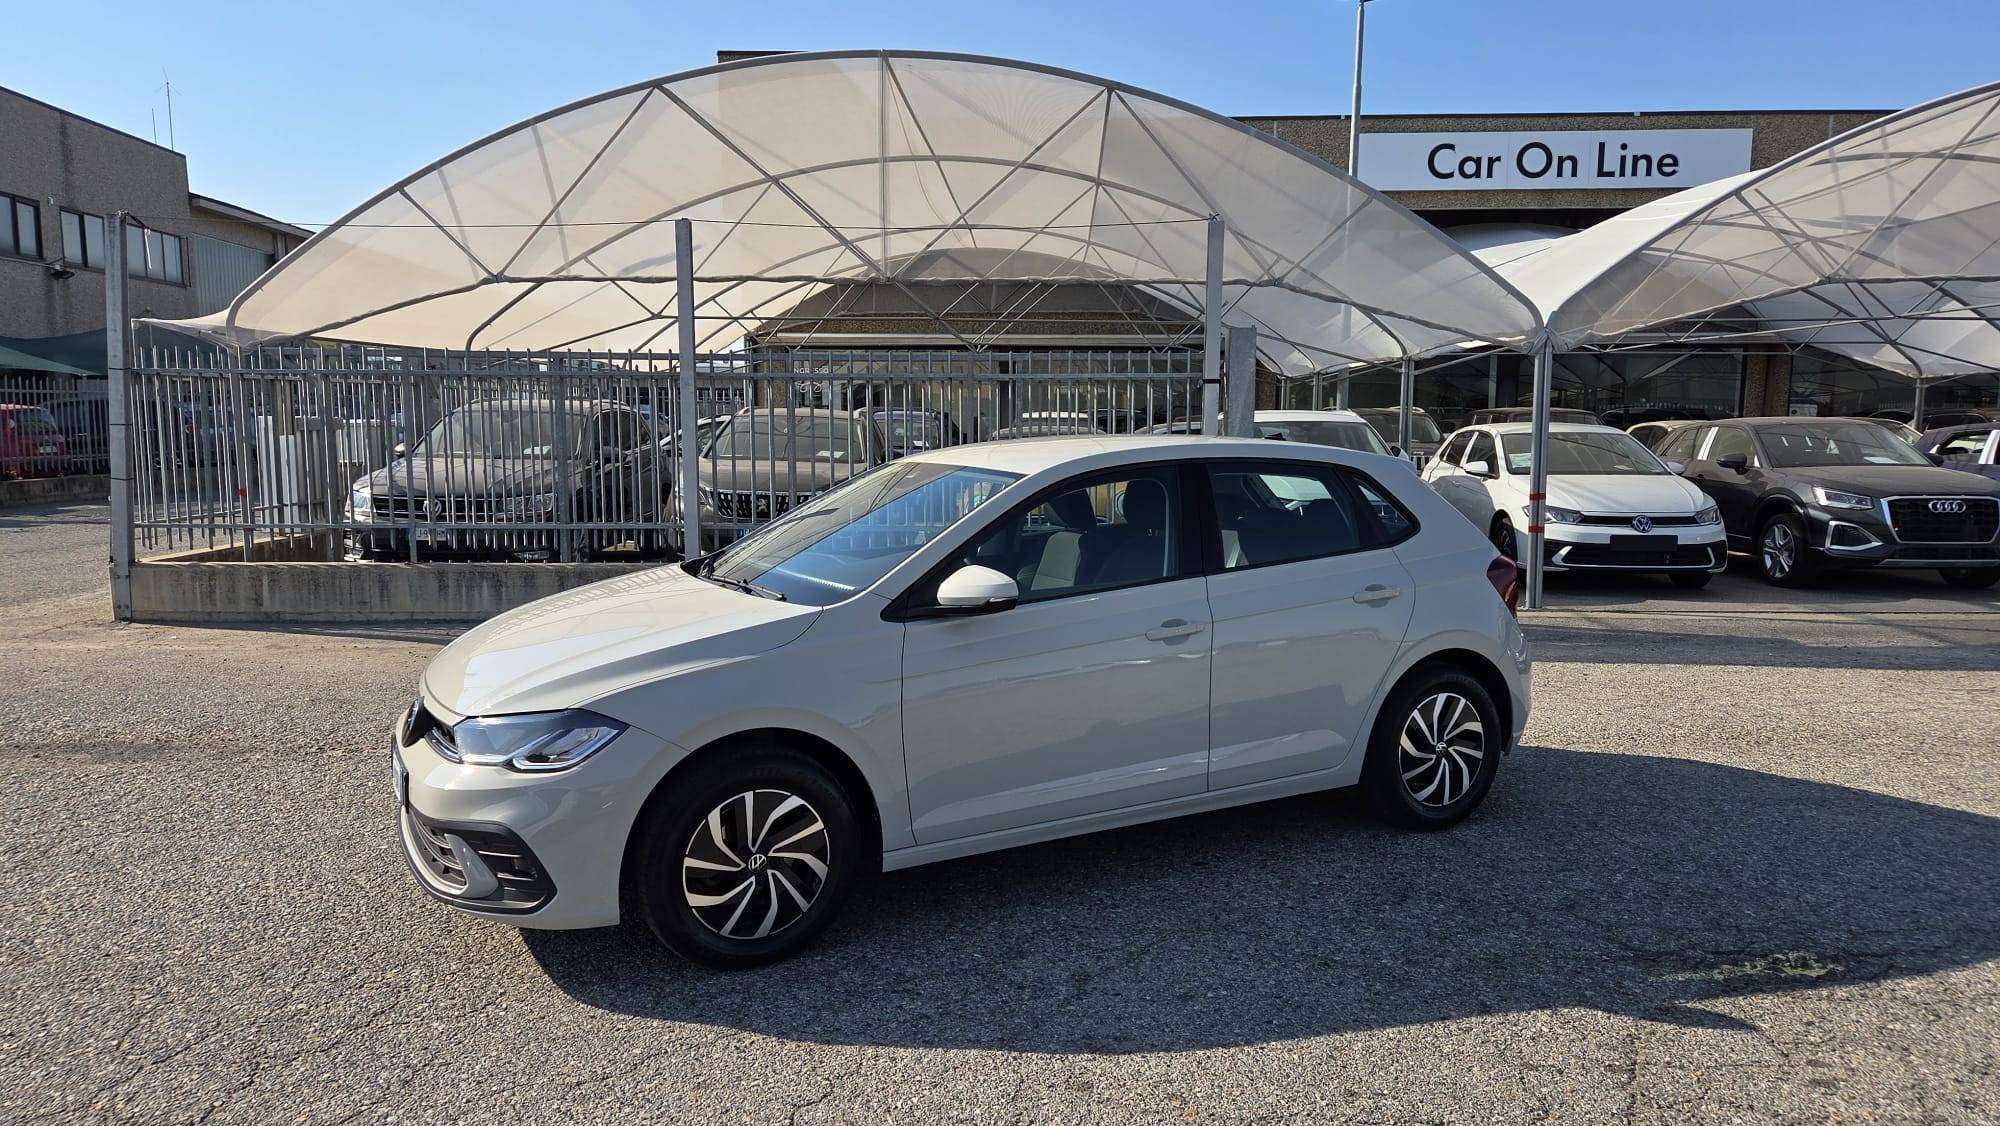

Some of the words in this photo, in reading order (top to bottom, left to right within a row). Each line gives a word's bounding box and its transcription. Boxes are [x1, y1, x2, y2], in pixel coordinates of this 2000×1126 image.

[1427, 143, 1502, 180] Car
[1516, 141, 1578, 179] On
[1596, 141, 1680, 178] Line
